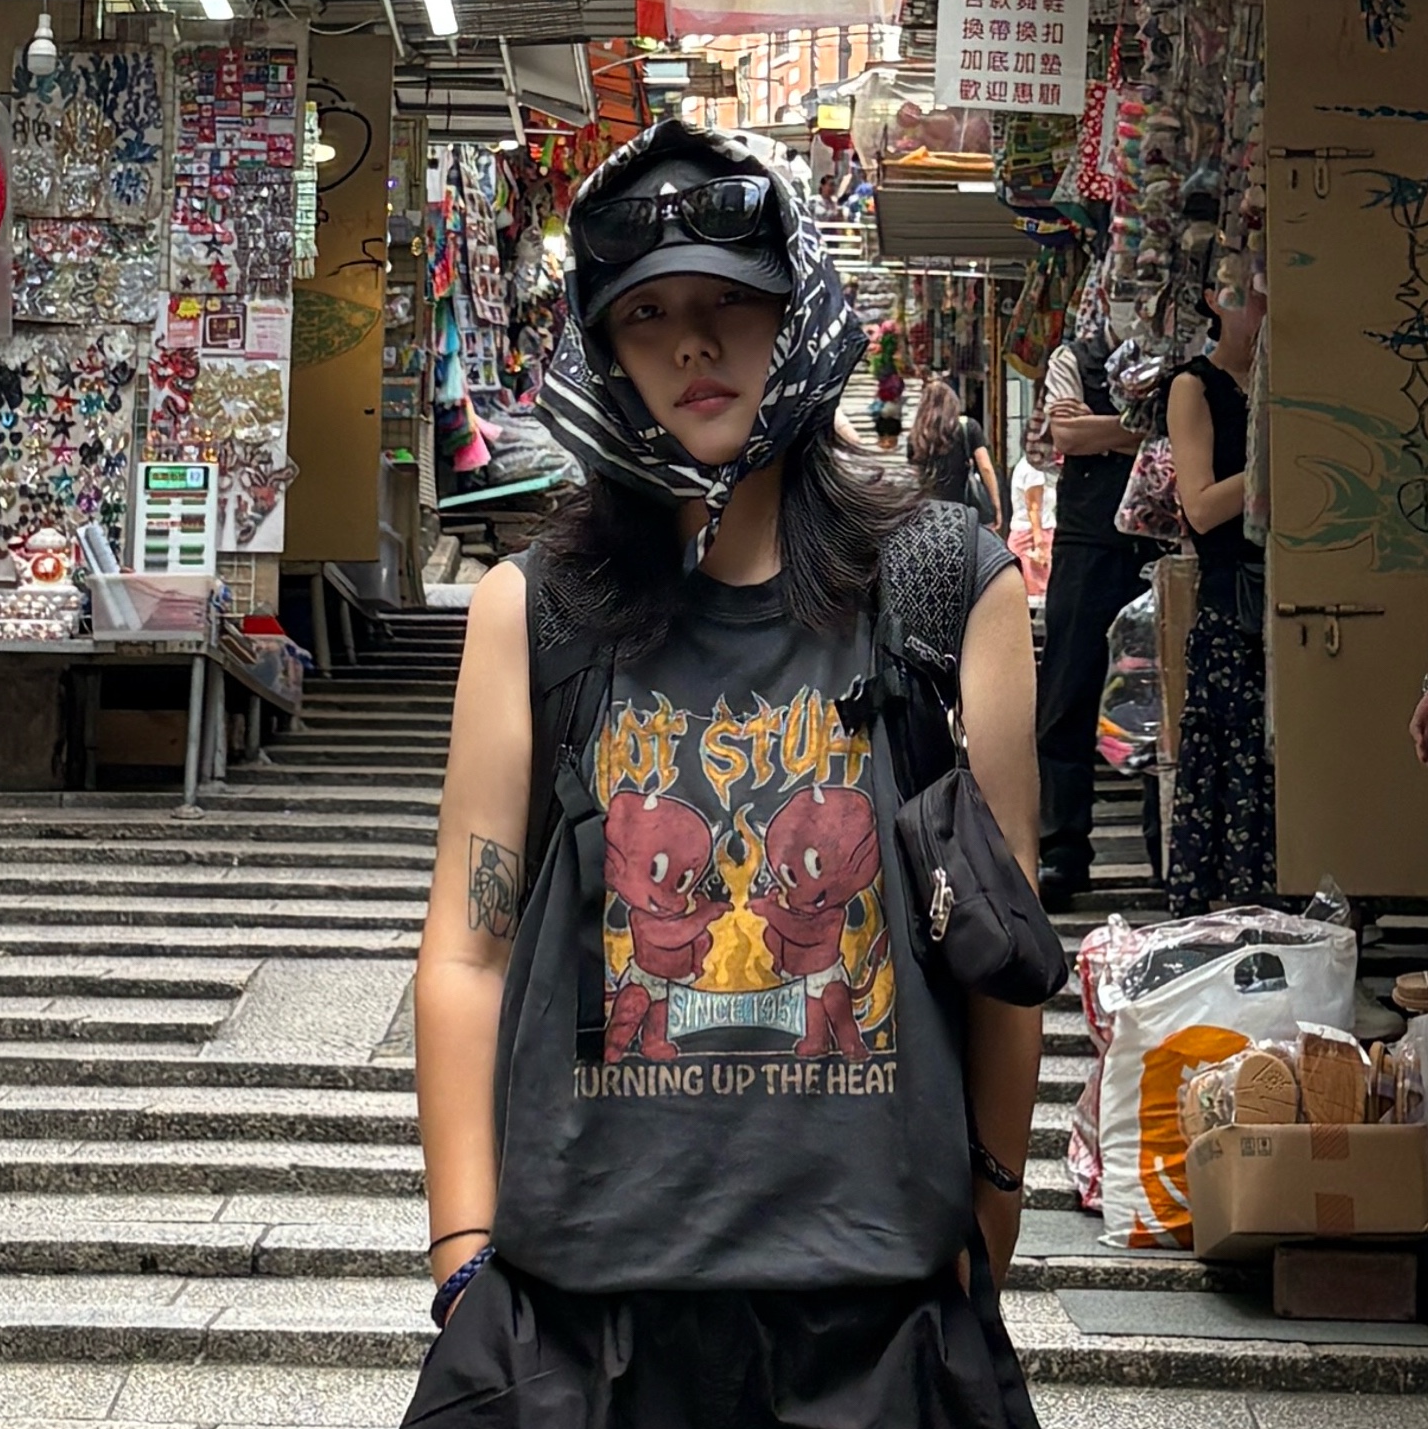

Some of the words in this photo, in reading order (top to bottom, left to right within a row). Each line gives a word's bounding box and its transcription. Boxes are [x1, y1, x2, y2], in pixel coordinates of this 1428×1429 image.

[962, 16, 1063, 44] 換帶換扣
[960, 49, 1062, 76] 加底加墊
[959, 79, 1061, 106] 歡迎惠顧
[671, 992, 748, 1029] SINCE
[712, 1065, 756, 1096] UP
[761, 1064, 821, 1096] THE
[828, 1064, 897, 1096] HEAT
